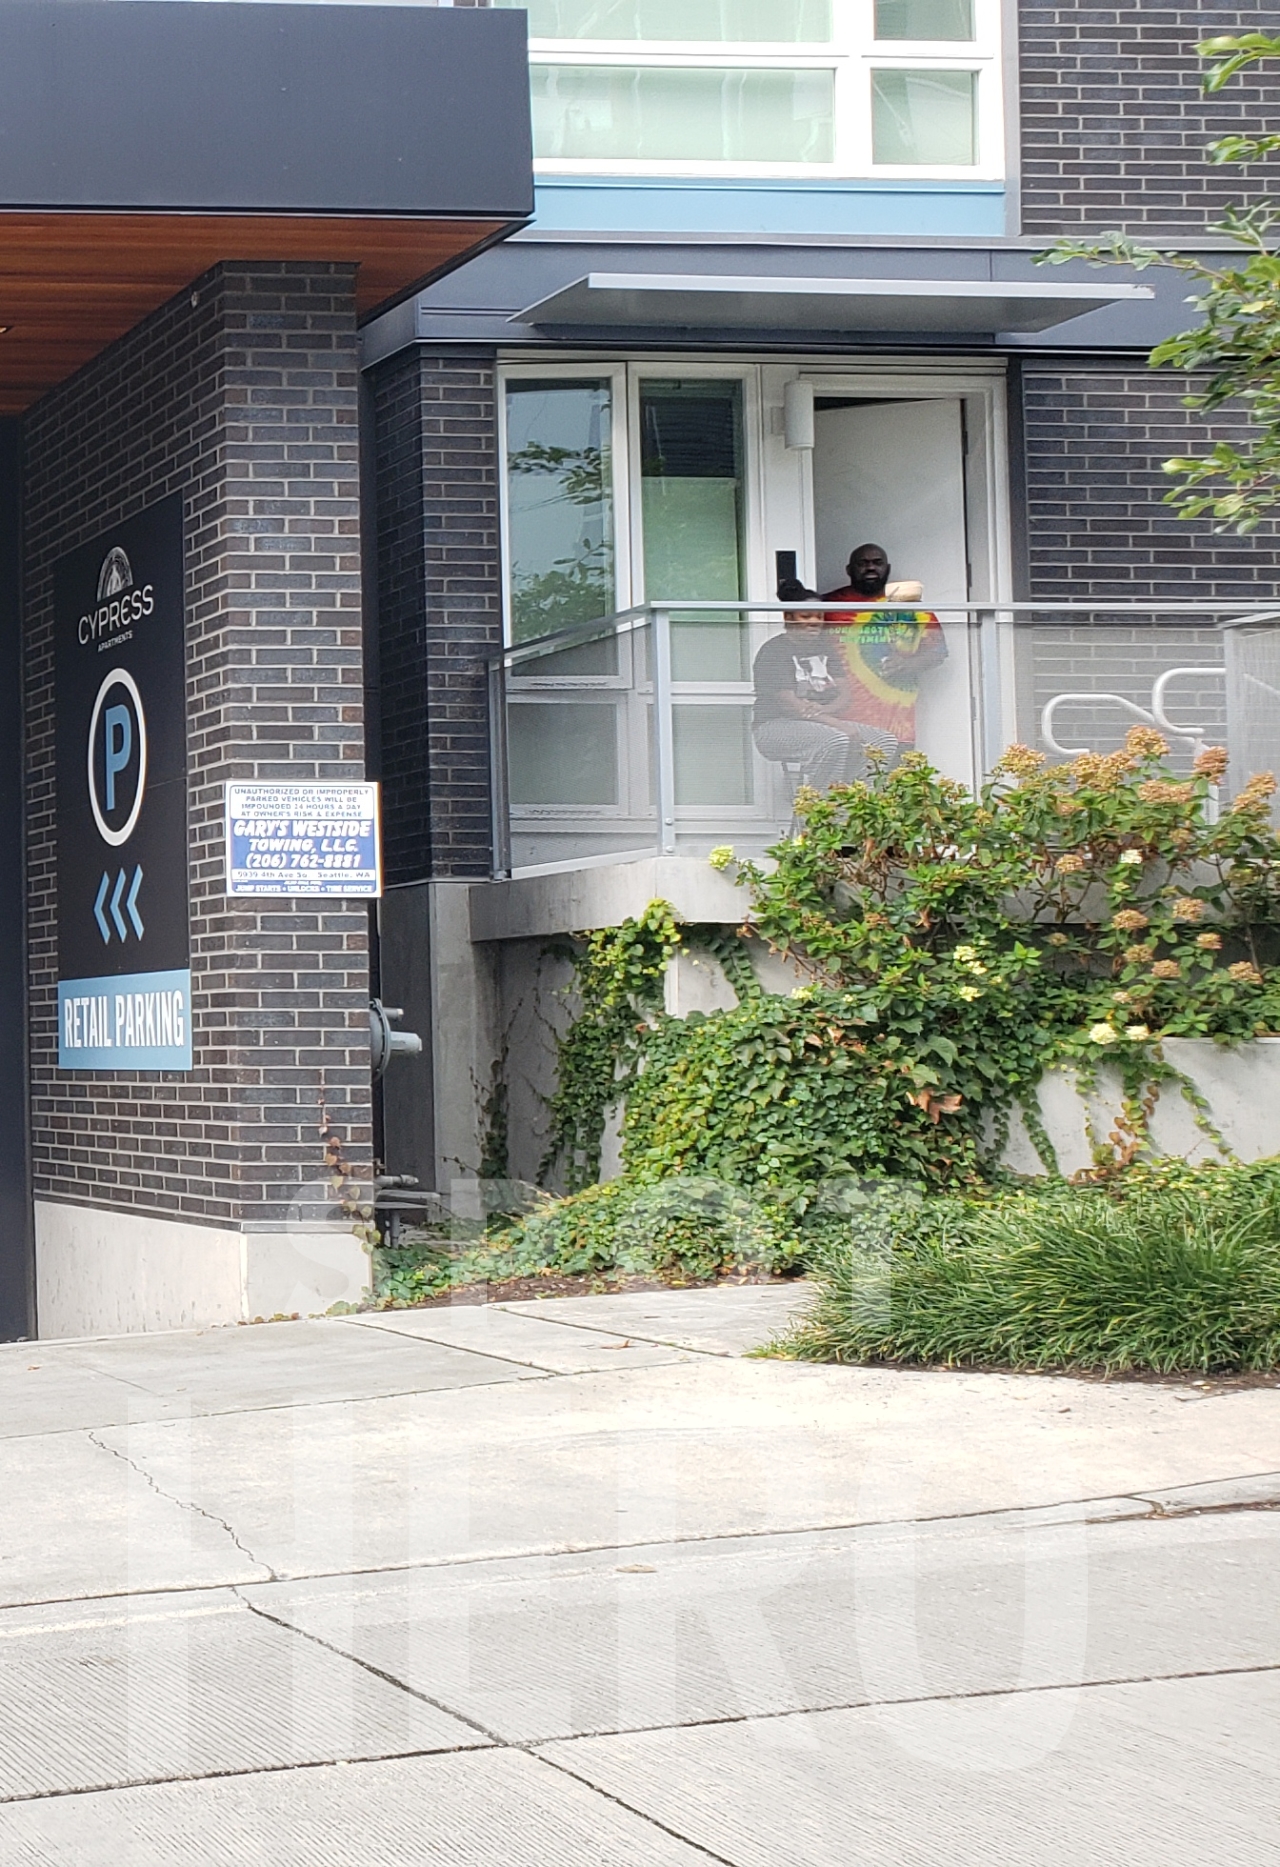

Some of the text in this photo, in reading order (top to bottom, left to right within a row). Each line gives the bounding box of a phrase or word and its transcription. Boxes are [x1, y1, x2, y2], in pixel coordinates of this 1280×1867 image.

[78, 584, 154, 645] CYPRESS
[105, 704, 132, 811] P
[233, 819, 372, 837] GARY'S WESTSIDE
[246, 852, 361, 869] (206) 762-8881
[64, 989, 185, 1048] RETAIL PARKING
